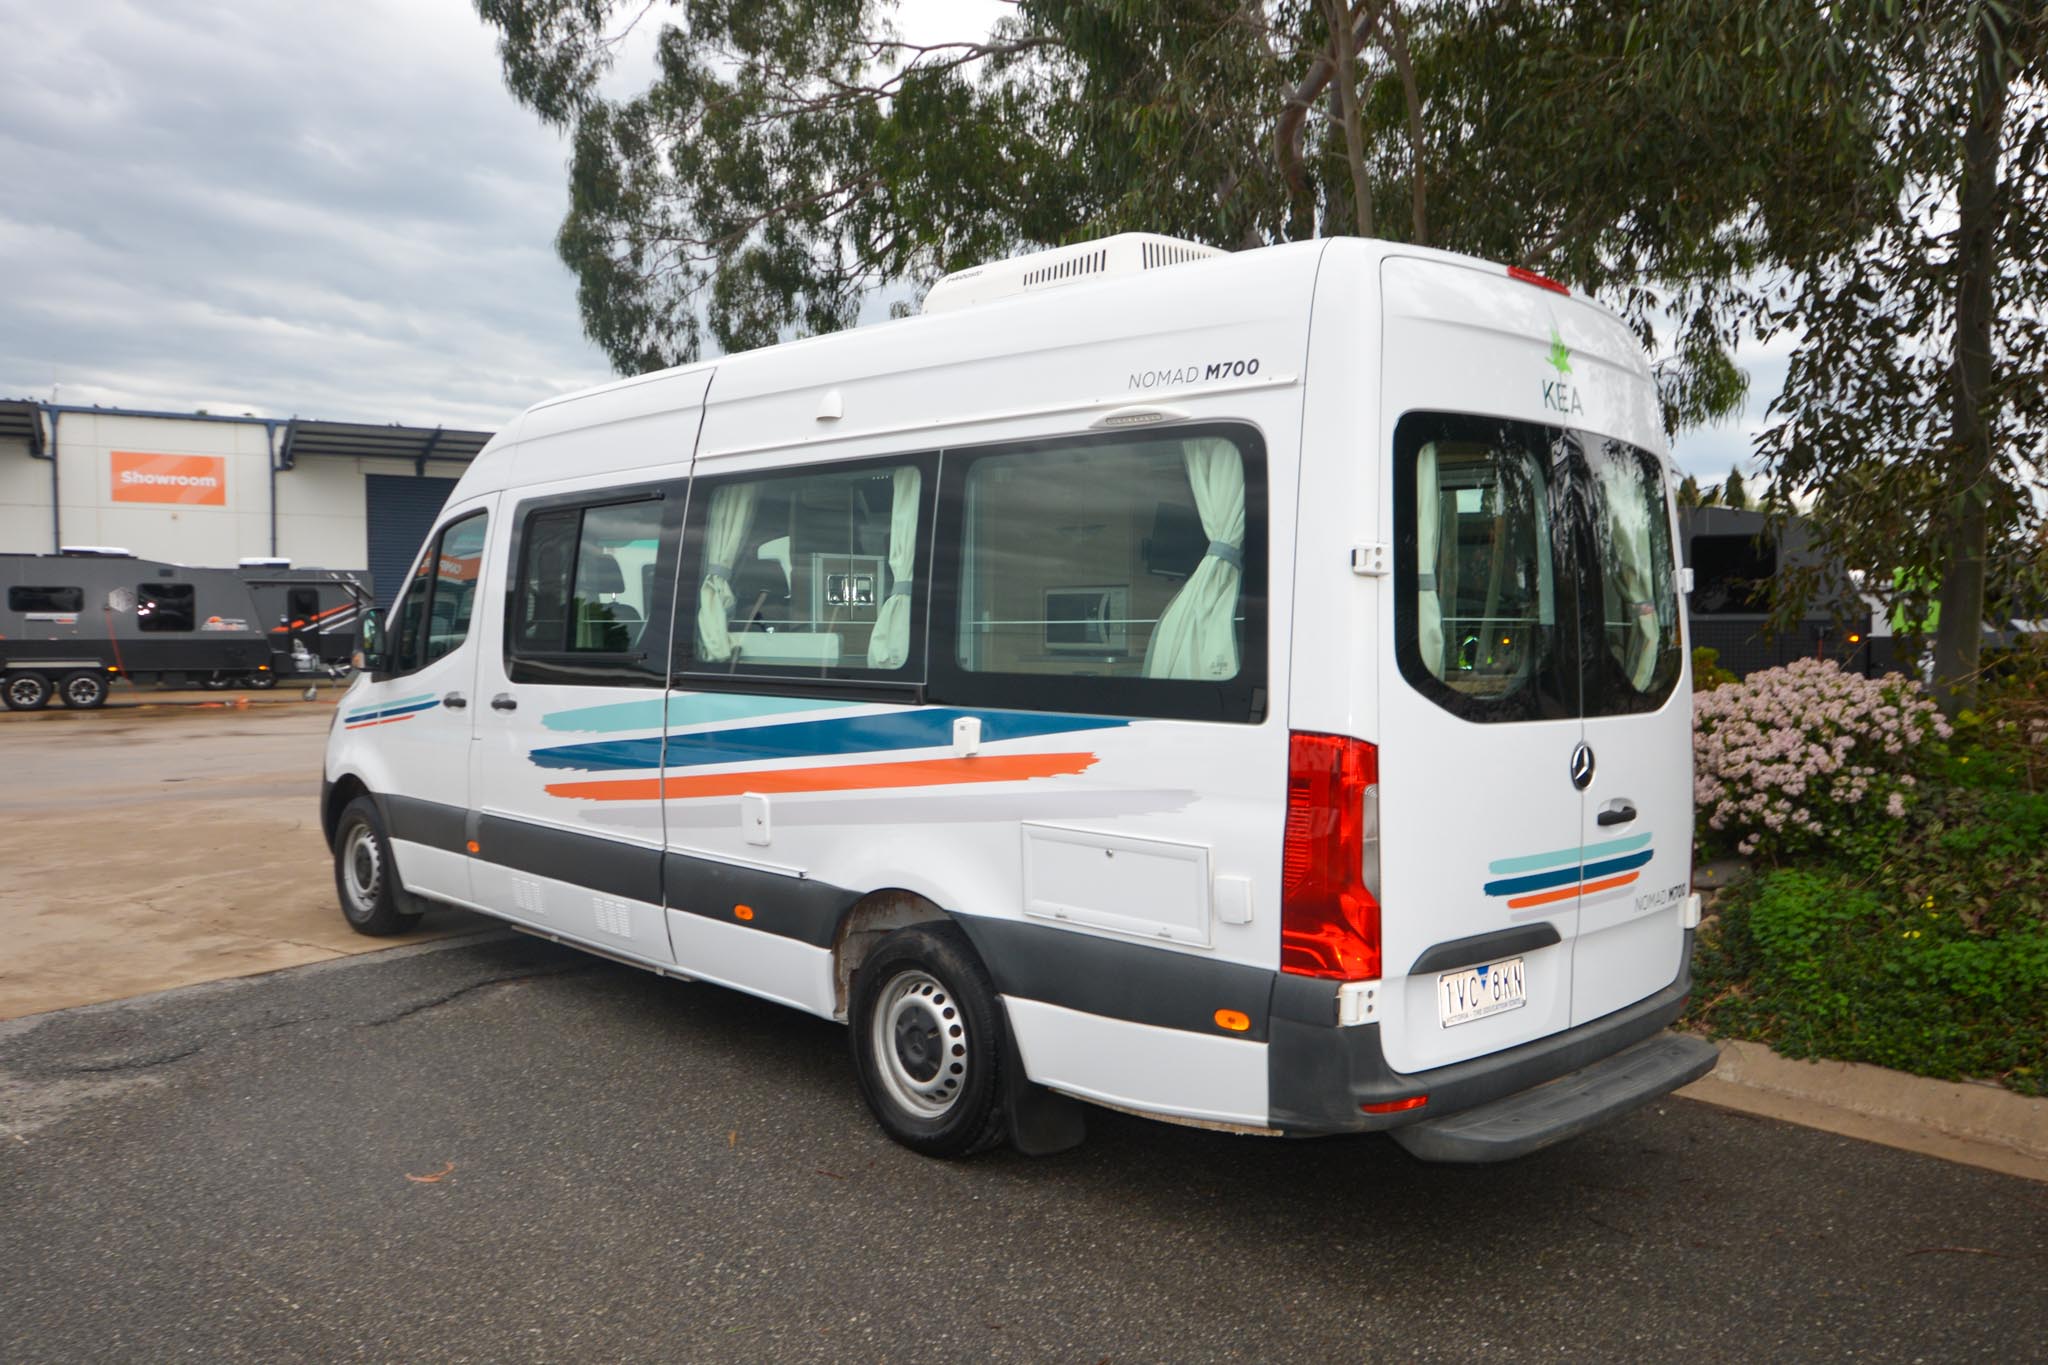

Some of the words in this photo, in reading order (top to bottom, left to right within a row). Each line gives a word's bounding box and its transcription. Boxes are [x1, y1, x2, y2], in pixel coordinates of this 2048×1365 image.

[1128, 366, 1199, 390] NOMAD
[1205, 358, 1260, 381] M700
[1542, 379, 1584, 416] KEA
[121, 470, 217, 487] Showroom
[1634, 888, 1666, 912] NOMAD
[1668, 882, 1686, 902] M700
[1446, 977, 1479, 1015] 1VC
[1493, 965, 1522, 1001] 8KN
